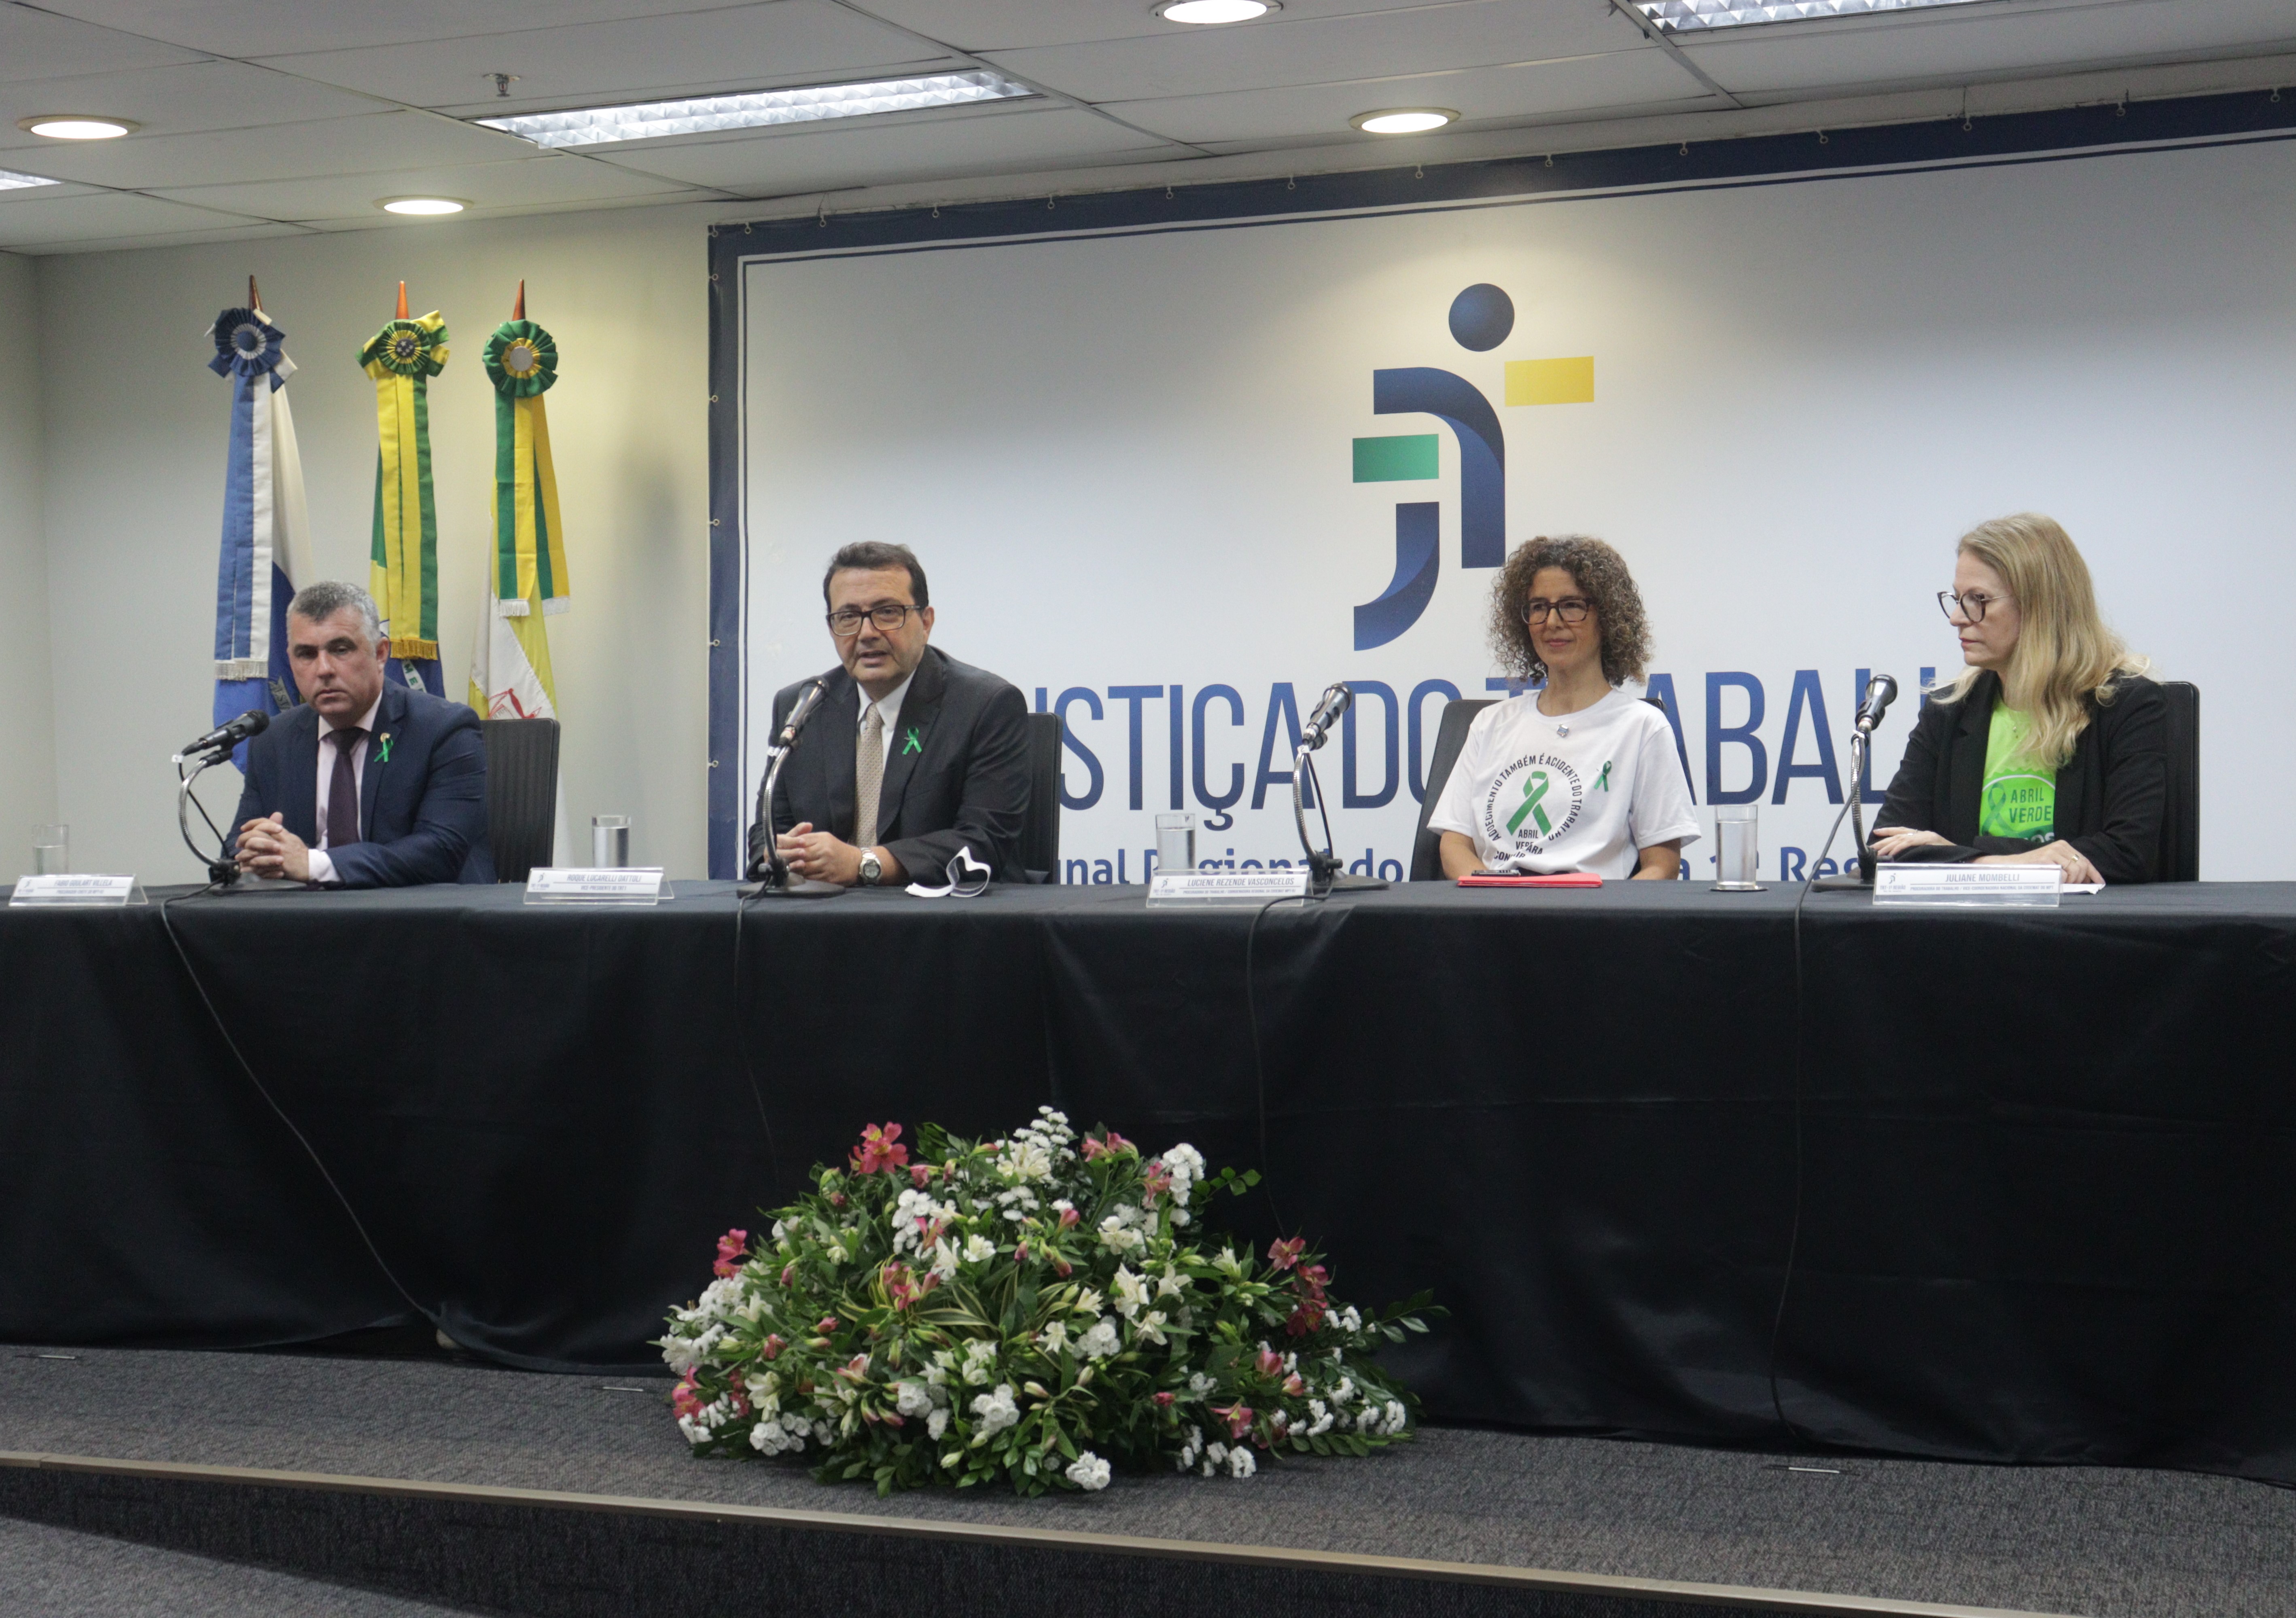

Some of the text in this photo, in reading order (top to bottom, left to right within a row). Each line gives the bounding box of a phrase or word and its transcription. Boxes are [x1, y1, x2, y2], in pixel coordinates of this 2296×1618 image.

[1499, 754, 1536, 780] TAMBÉM
[1546, 756, 1580, 785] ACIDENTE
[1572, 785, 1582, 796] DO
[2010, 787, 2044, 803] ABRIL
[2009, 805, 2052, 823] VERDE
[1518, 829, 1539, 839] ABRIL
[1979, 873, 2020, 881] MOMBELLI
